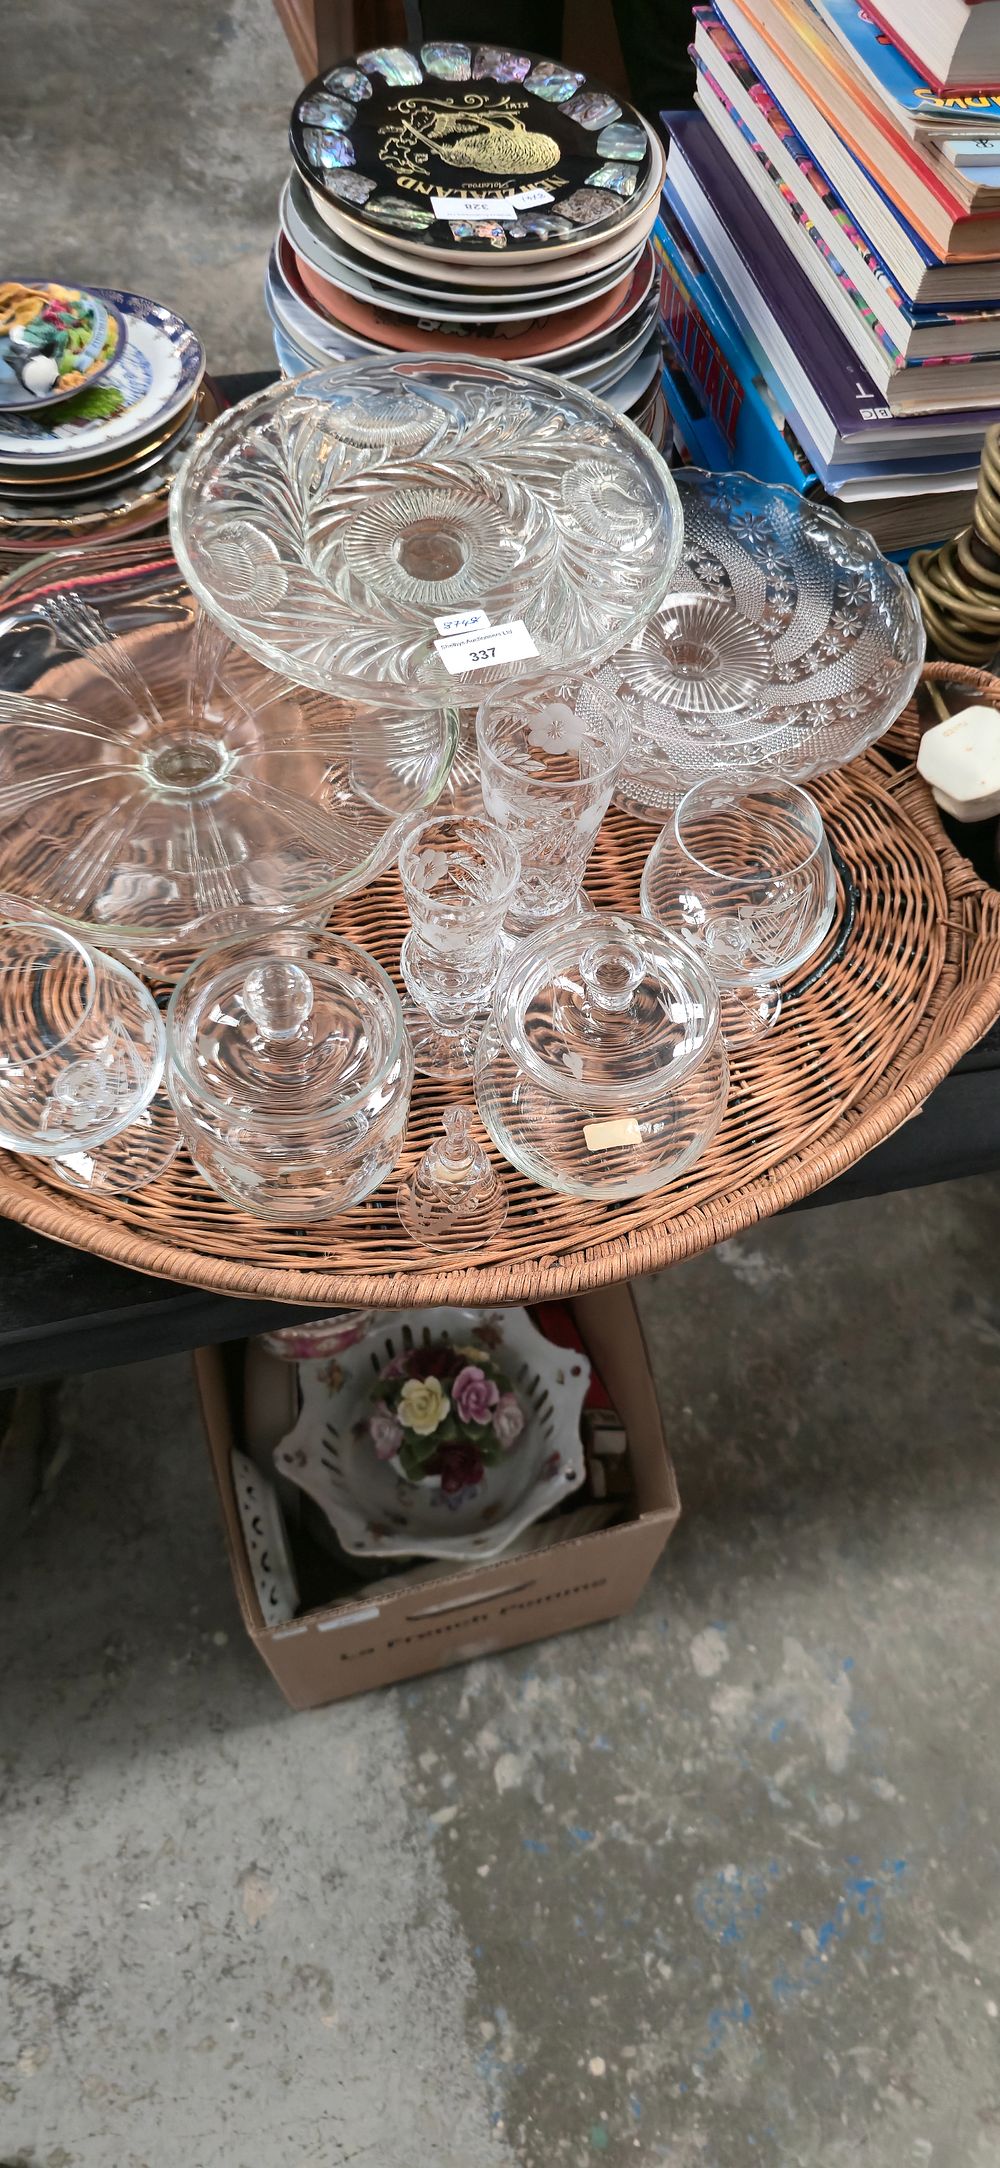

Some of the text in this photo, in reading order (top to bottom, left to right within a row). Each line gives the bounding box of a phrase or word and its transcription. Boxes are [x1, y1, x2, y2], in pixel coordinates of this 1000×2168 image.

[396, 175, 515, 199] ZEALAND
[464, 203, 489, 211] 328
[469, 647, 496, 662] 337
[387, 1612, 488, 1649] French
